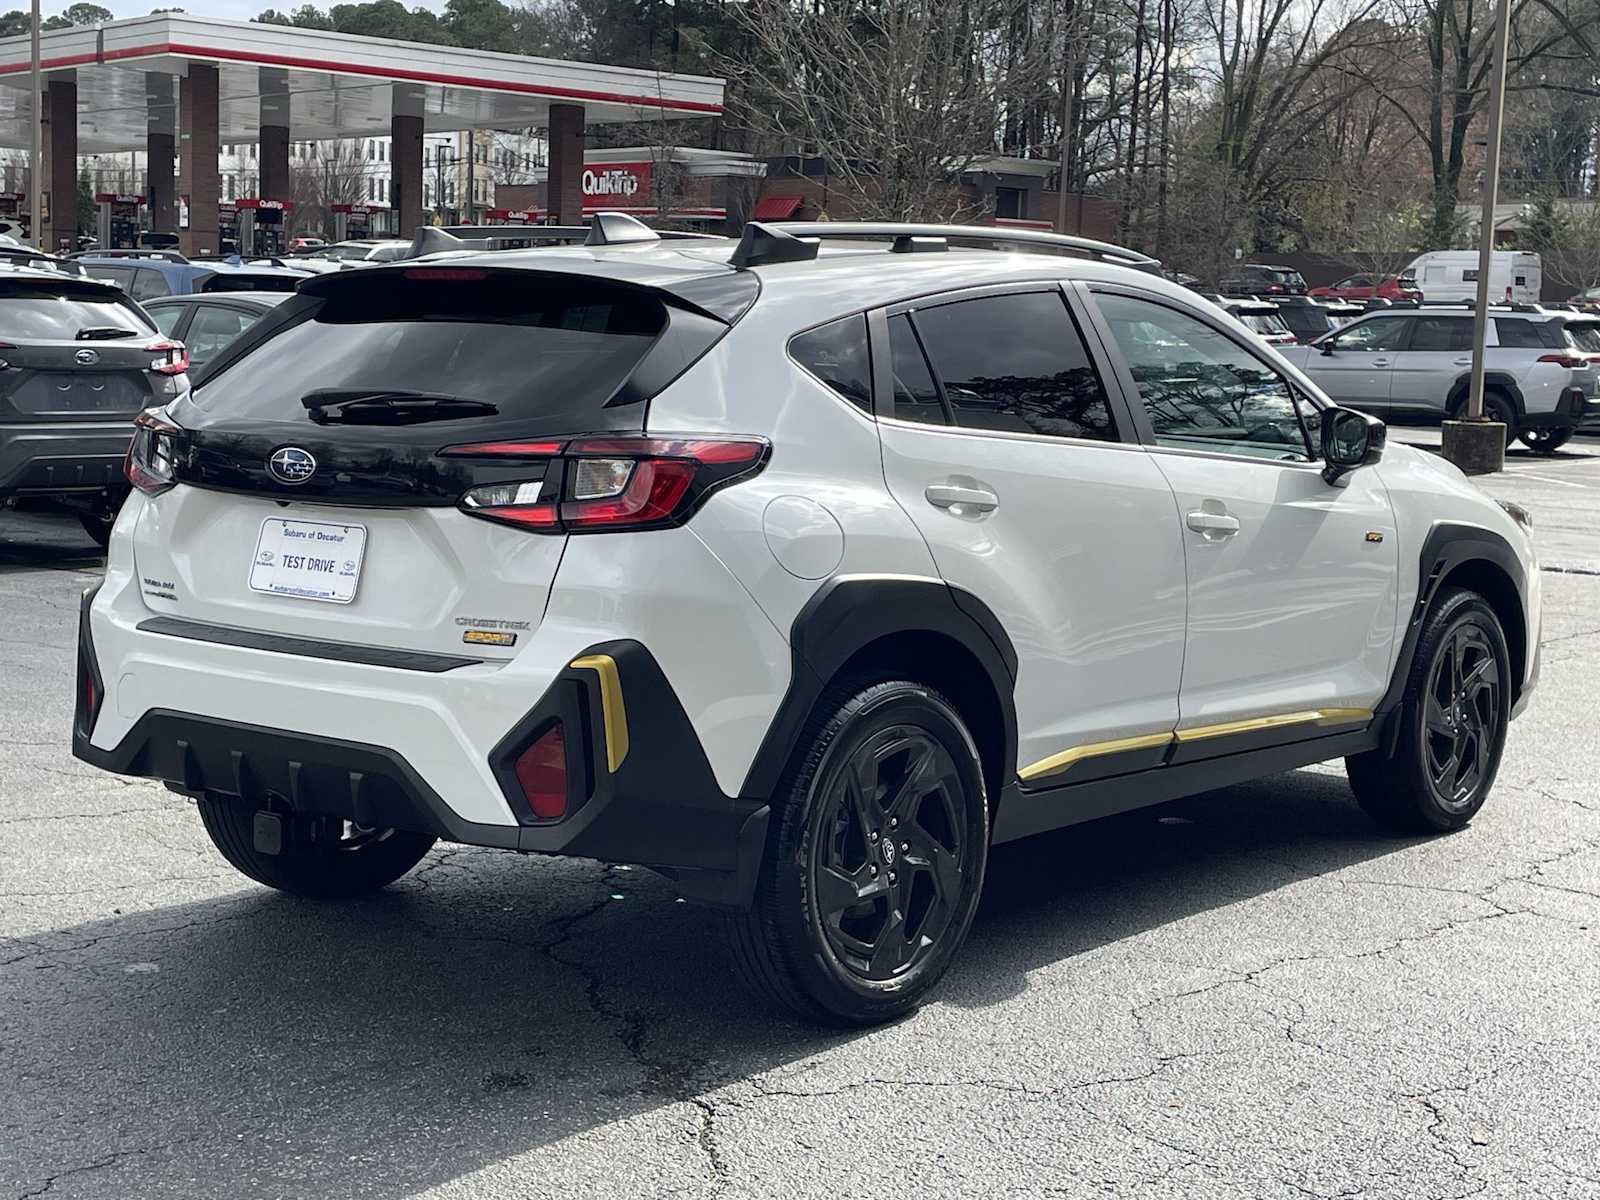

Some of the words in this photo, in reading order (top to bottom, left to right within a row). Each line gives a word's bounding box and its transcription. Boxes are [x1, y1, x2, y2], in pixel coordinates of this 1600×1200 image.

[582, 169, 638, 196] QuikTrip
[284, 528, 306, 538] Subaru
[308, 531, 315, 539] of
[317, 531, 344, 542] Decatur
[282, 555, 306, 569] TEST
[307, 557, 336, 573] DRIVE
